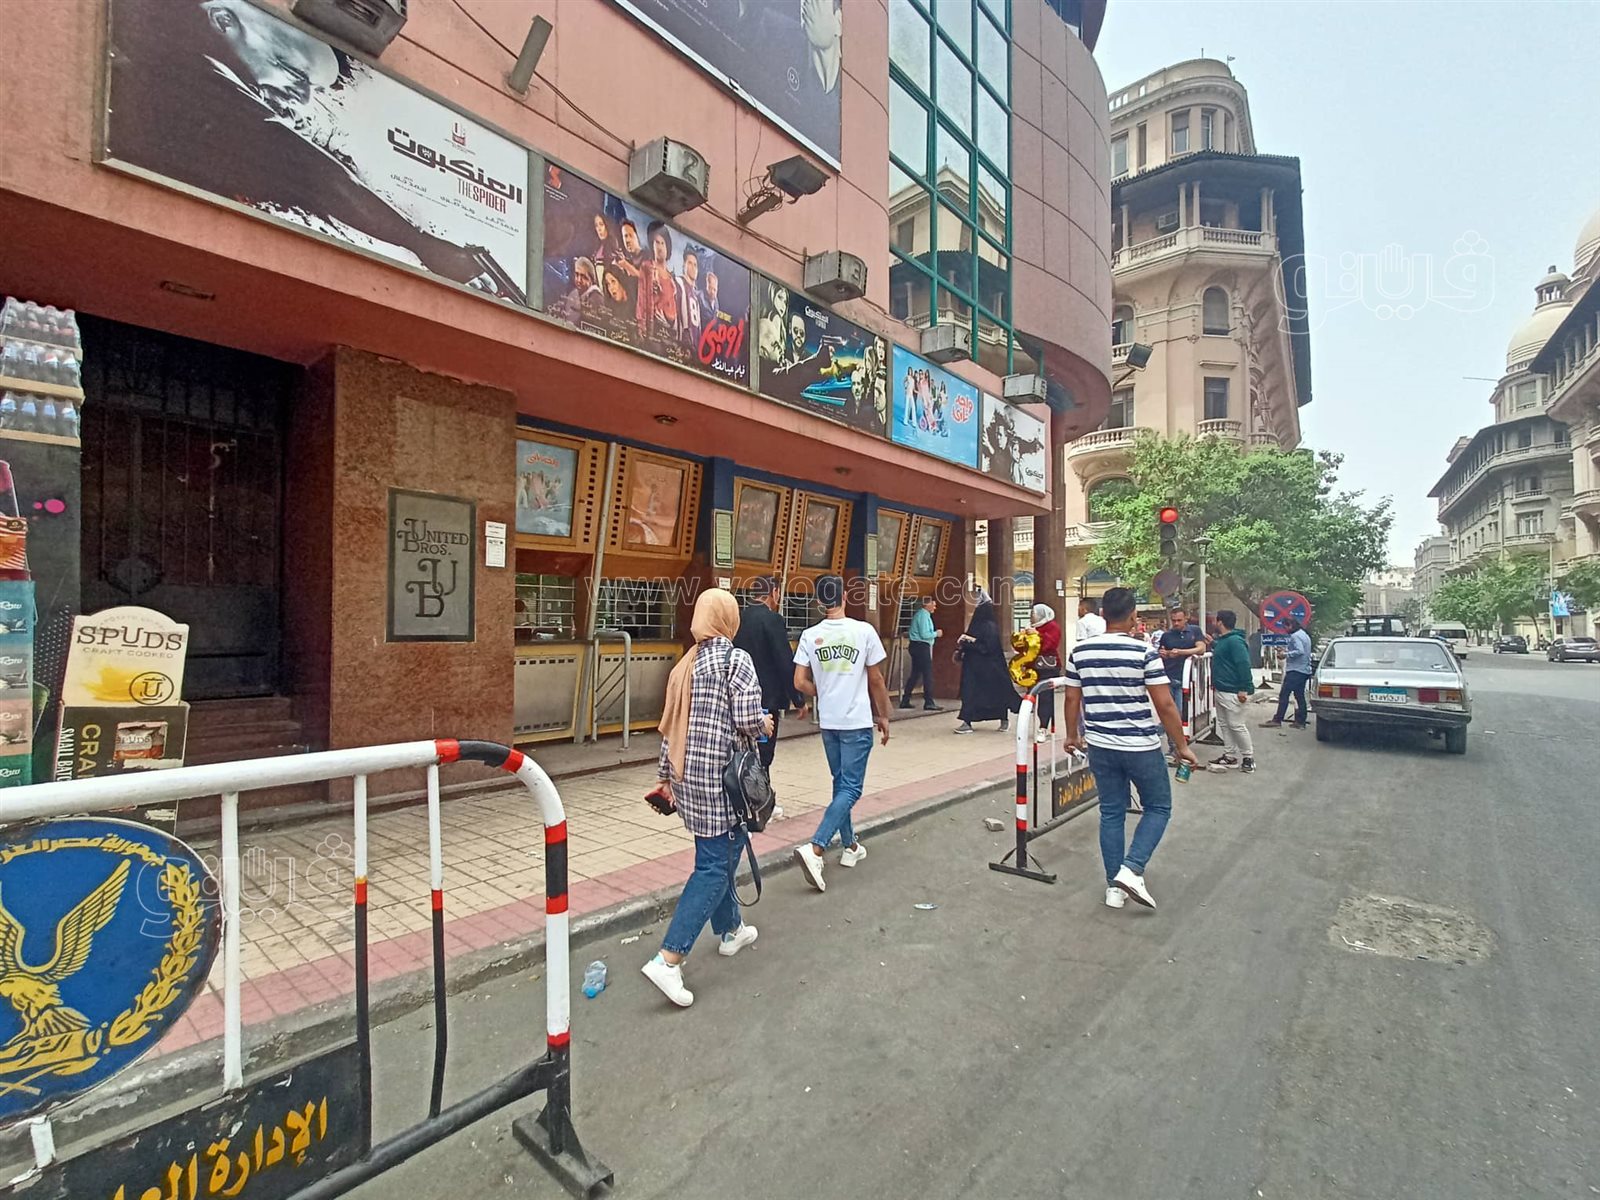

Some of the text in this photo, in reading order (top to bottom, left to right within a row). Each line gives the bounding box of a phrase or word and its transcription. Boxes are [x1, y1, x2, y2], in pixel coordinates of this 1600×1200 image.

[387, 127, 522, 204] العنكبوت
[397, 530, 452, 555] BROS.
[403, 518, 469, 546] UNITED
[77, 625, 183, 651] SPUDS
[77, 724, 101, 778] CRA
[48, 837, 104, 853] مصر
[207, 1096, 328, 1197] الإدارة
